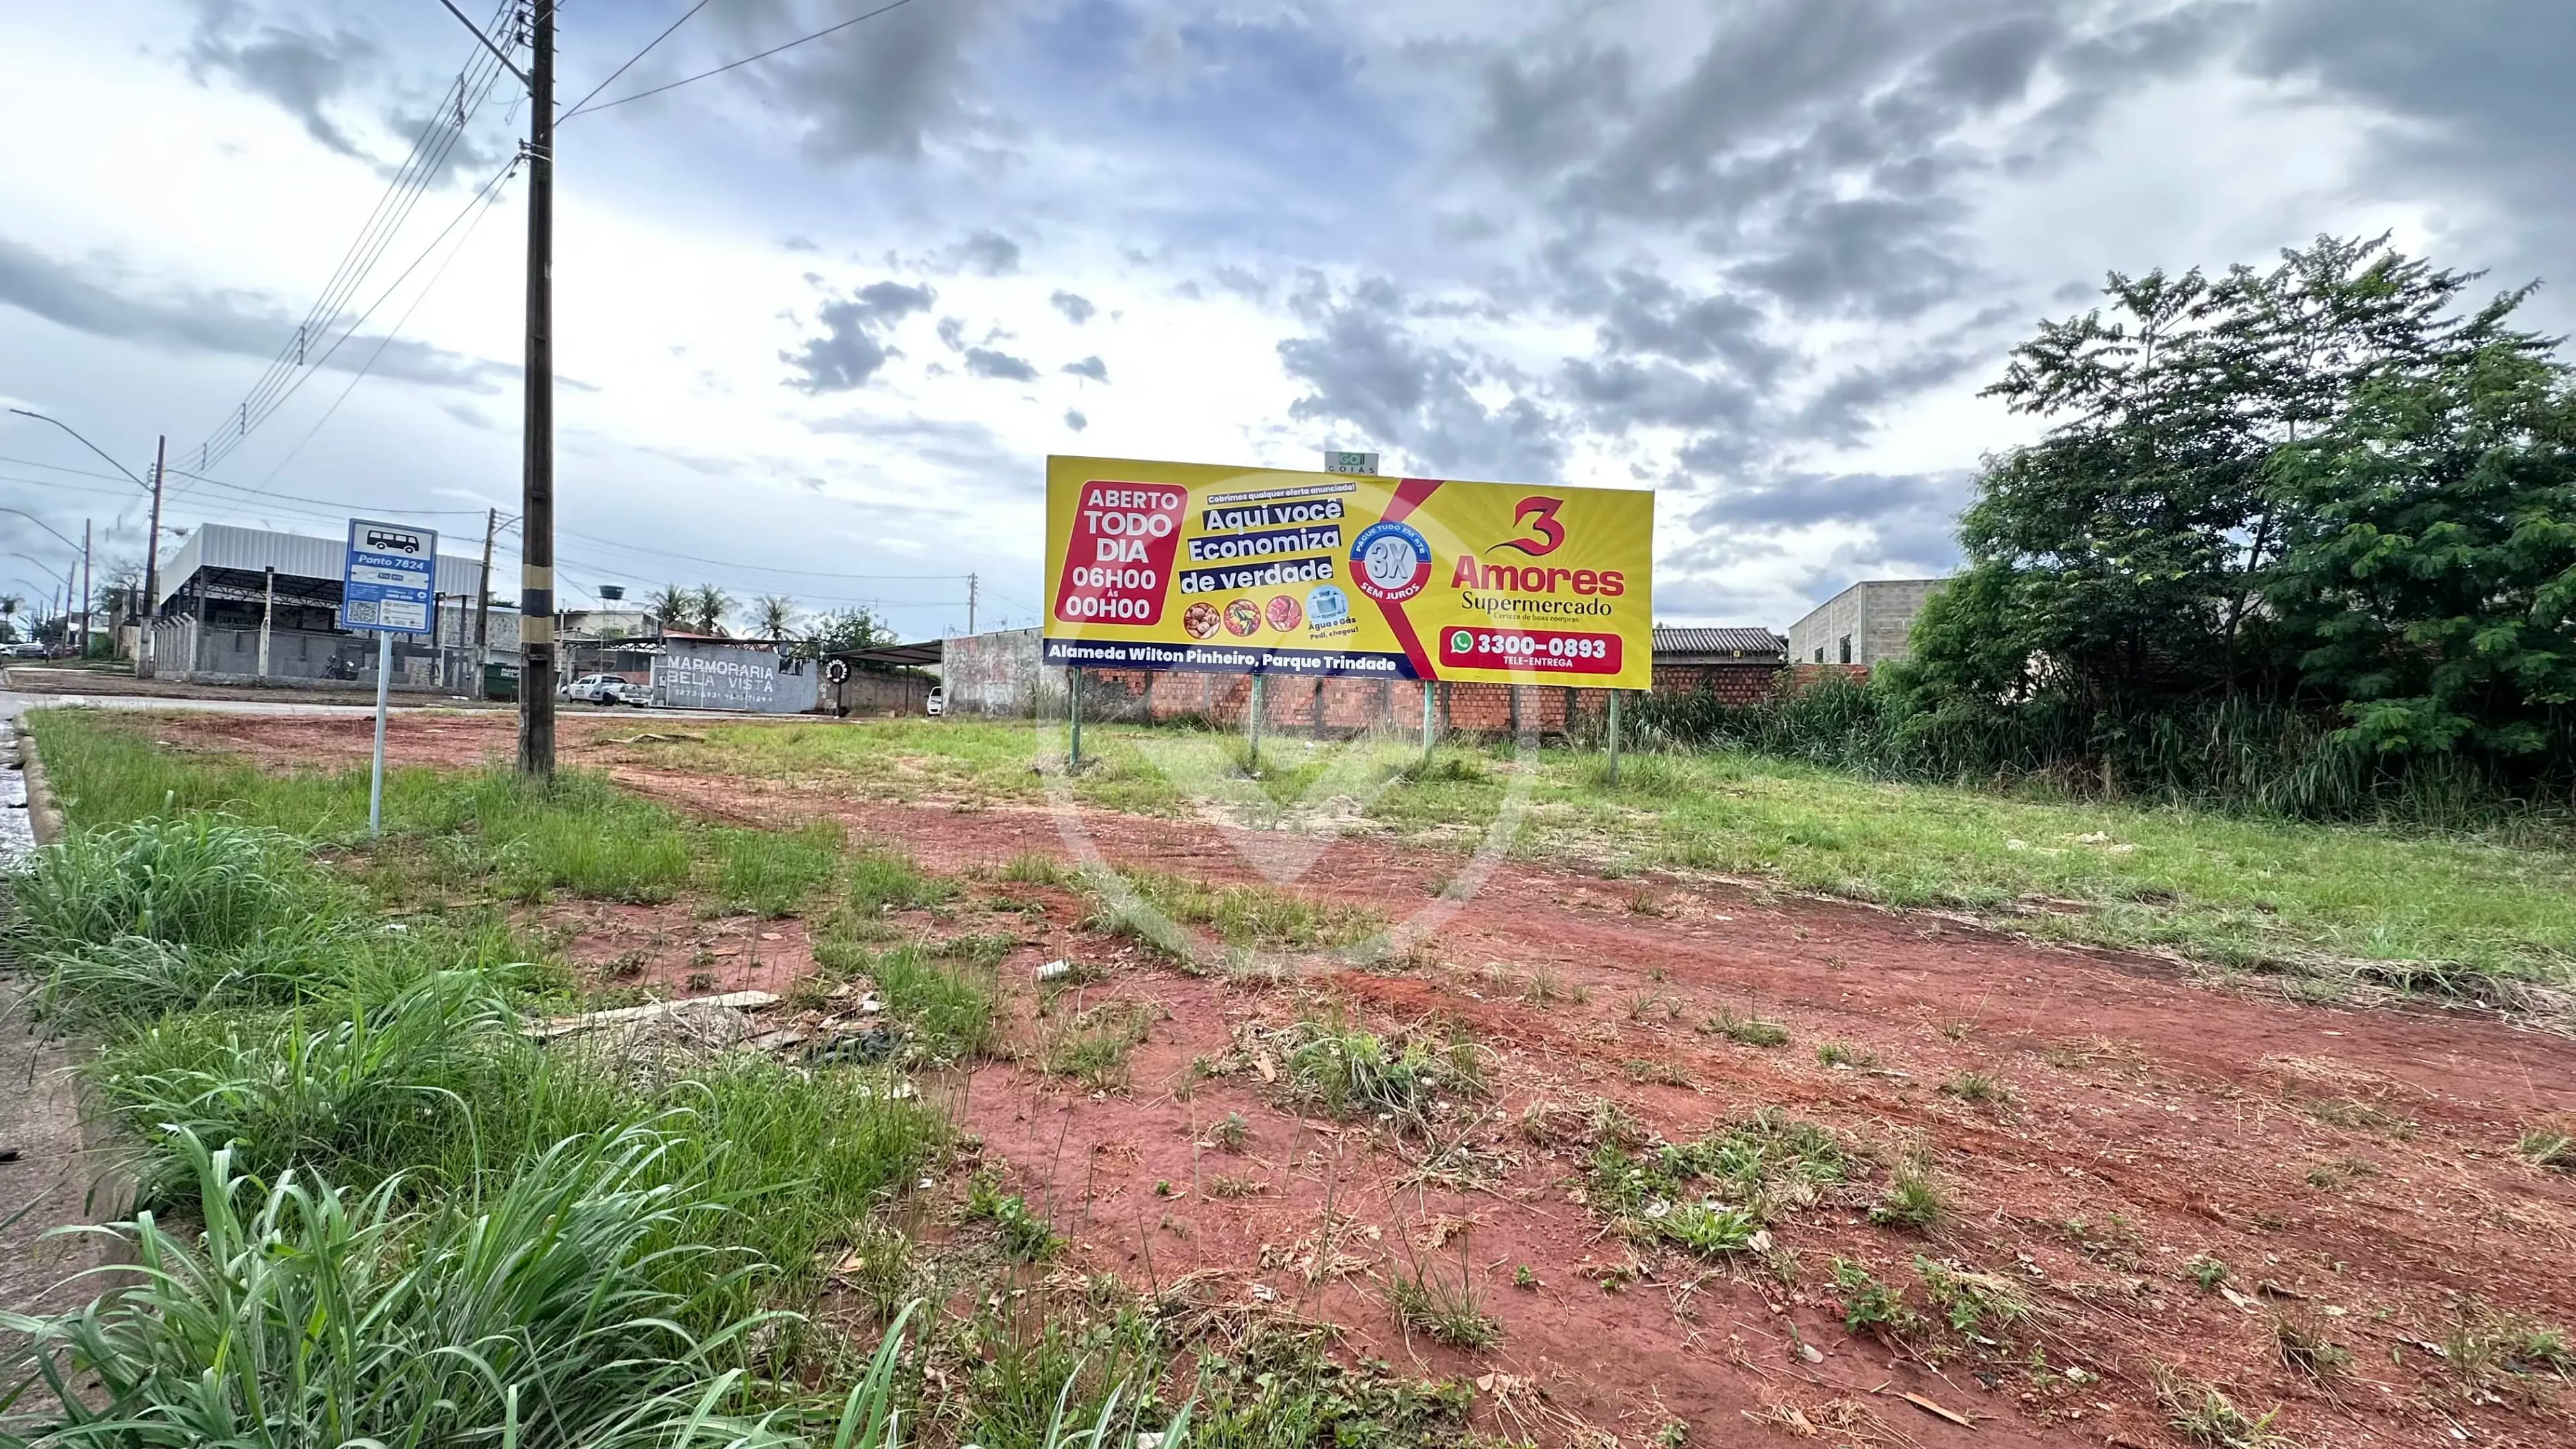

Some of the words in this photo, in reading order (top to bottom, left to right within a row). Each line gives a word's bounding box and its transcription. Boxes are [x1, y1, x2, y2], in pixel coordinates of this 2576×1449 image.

[1087, 489, 1179, 511] ABERTO
[1208, 494, 1247, 503] Cobrimos
[1248, 490, 1285, 501] qualquer
[1285, 488, 1309, 496] oferta
[1310, 483, 1355, 494] anunciada!
[1083, 511, 1173, 537] TODO
[1207, 504, 1270, 535] Aqui
[1275, 498, 1342, 523] você
[1189, 528, 1340, 561] Economiza
[1402, 528, 1414, 537] EM
[358, 554, 392, 566] Ponto
[395, 559, 424, 570] 7824
[1096, 538, 1149, 564] DIA
[1371, 543, 1408, 579] 3X
[1073, 566, 1157, 590] 06H00
[1181, 572, 1216, 594] de
[1220, 559, 1333, 589] verdade
[1451, 555, 1625, 596] Amores
[1360, 582, 1383, 598] SEM
[1385, 583, 1419, 599] JUROS
[1065, 596, 1150, 619] 00H00
[1461, 590, 1612, 616] Supermercado
[1308, 621, 1332, 631] Água
[1340, 616, 1356, 625] Gás
[1329, 626, 1358, 636] chegou!
[1049, 644, 1126, 660] Alameda
[1129, 647, 1183, 662] Wilton
[1186, 649, 1260, 667] Pinheiro,
[1263, 654, 1320, 672] Parque
[1324, 655, 1396, 672] Trindade
[1478, 634, 1605, 659] 3300-0893
[667, 655, 773, 680] MARMORARIA
[1503, 655, 1573, 667] TELE-ENTREGA
[667, 671, 714, 687] BELA
[729, 676, 773, 692] VISTA
